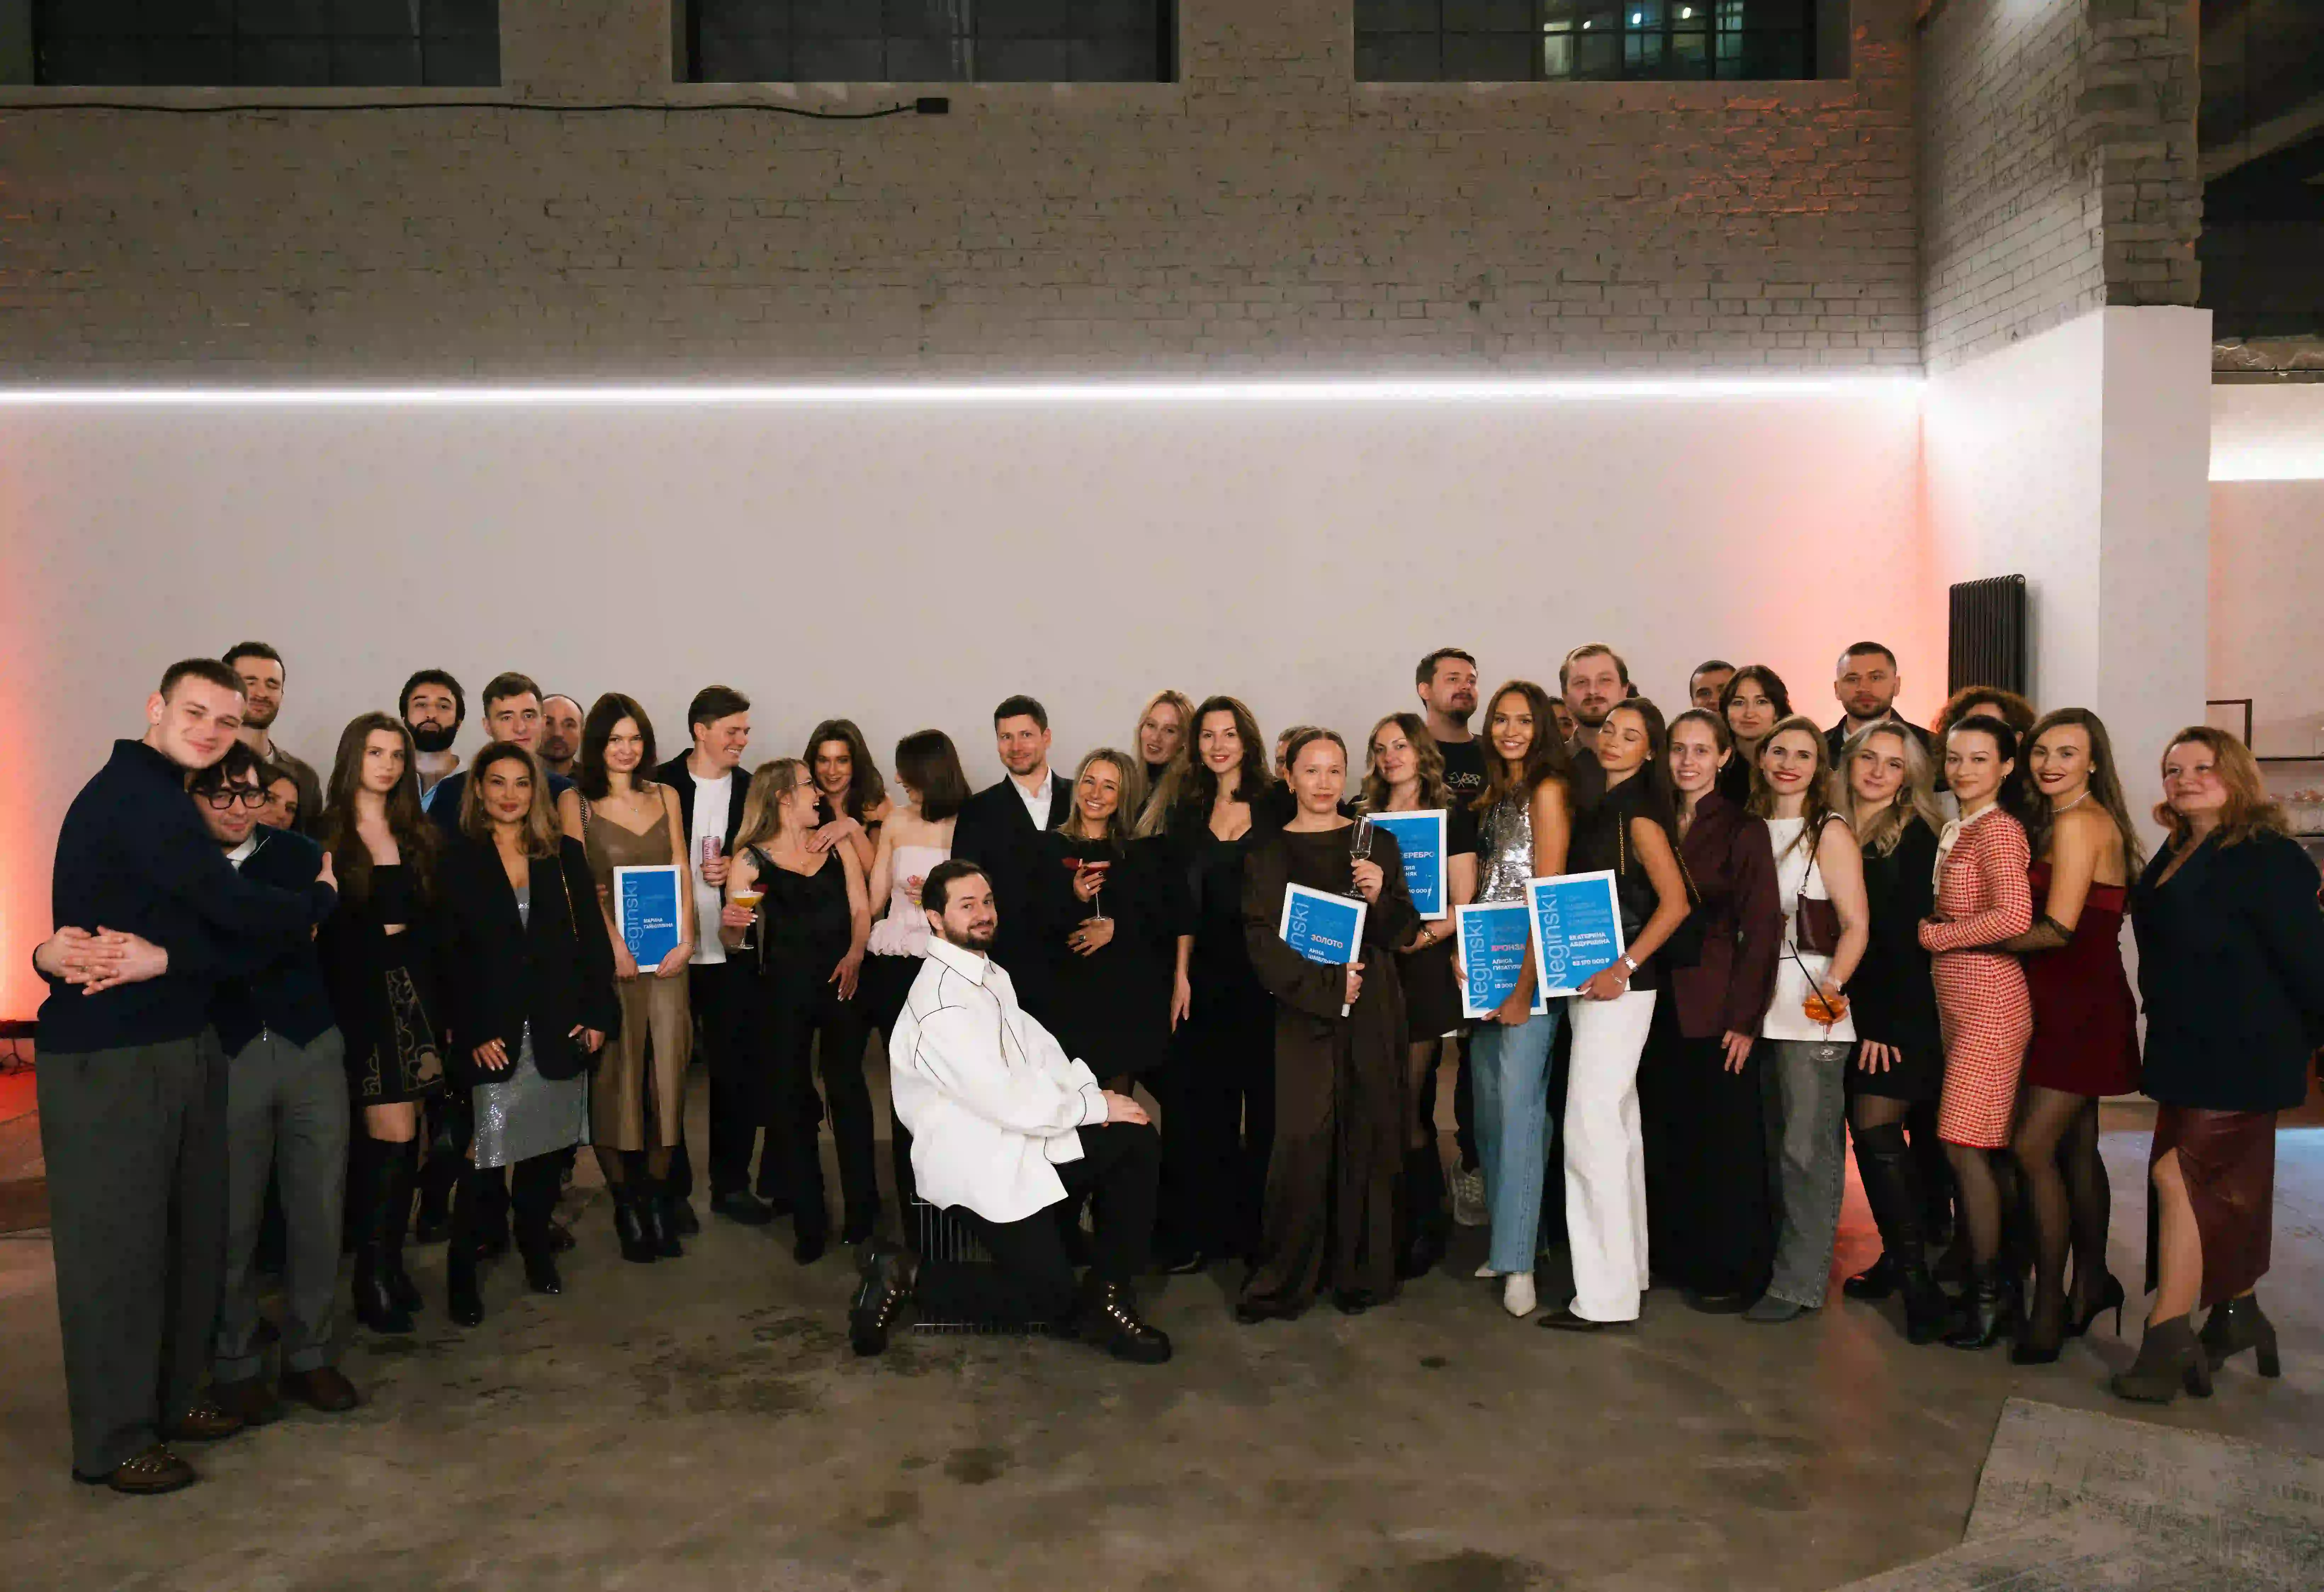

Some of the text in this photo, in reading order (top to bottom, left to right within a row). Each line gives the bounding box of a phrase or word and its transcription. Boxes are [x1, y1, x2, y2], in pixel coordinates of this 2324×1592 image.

[1290, 900, 1309, 958] inski
[1309, 948, 1324, 956] АННА
[1310, 934, 1343, 949] ЗОЛОТО
[1536, 894, 1573, 989] Neginski
[1464, 920, 1493, 1010] Neginski
